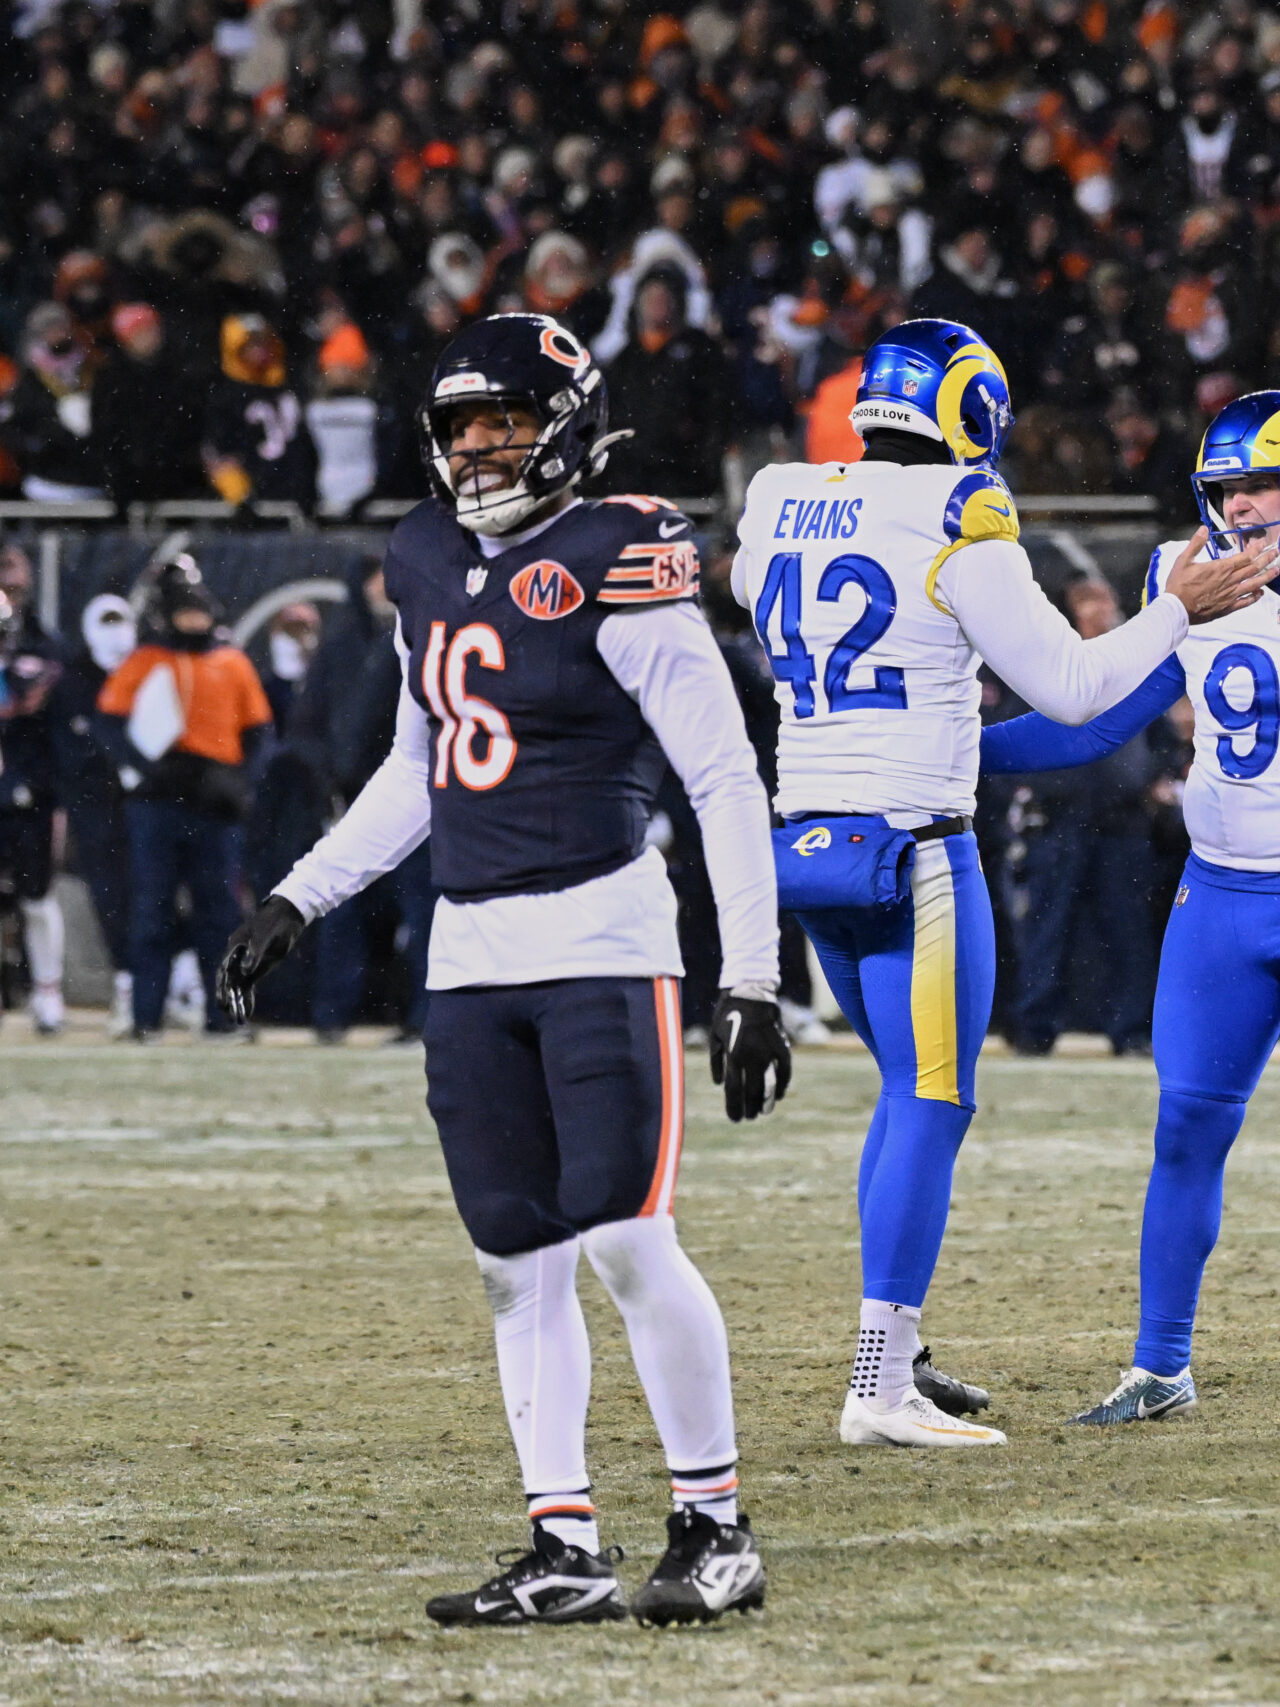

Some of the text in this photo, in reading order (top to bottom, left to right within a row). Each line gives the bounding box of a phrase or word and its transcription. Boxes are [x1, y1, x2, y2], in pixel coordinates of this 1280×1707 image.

[883, 410, 911, 422] LOVE
[774, 498, 863, 539] EVANS
[755, 552, 908, 720] 42
[422, 621, 518, 791] 16
